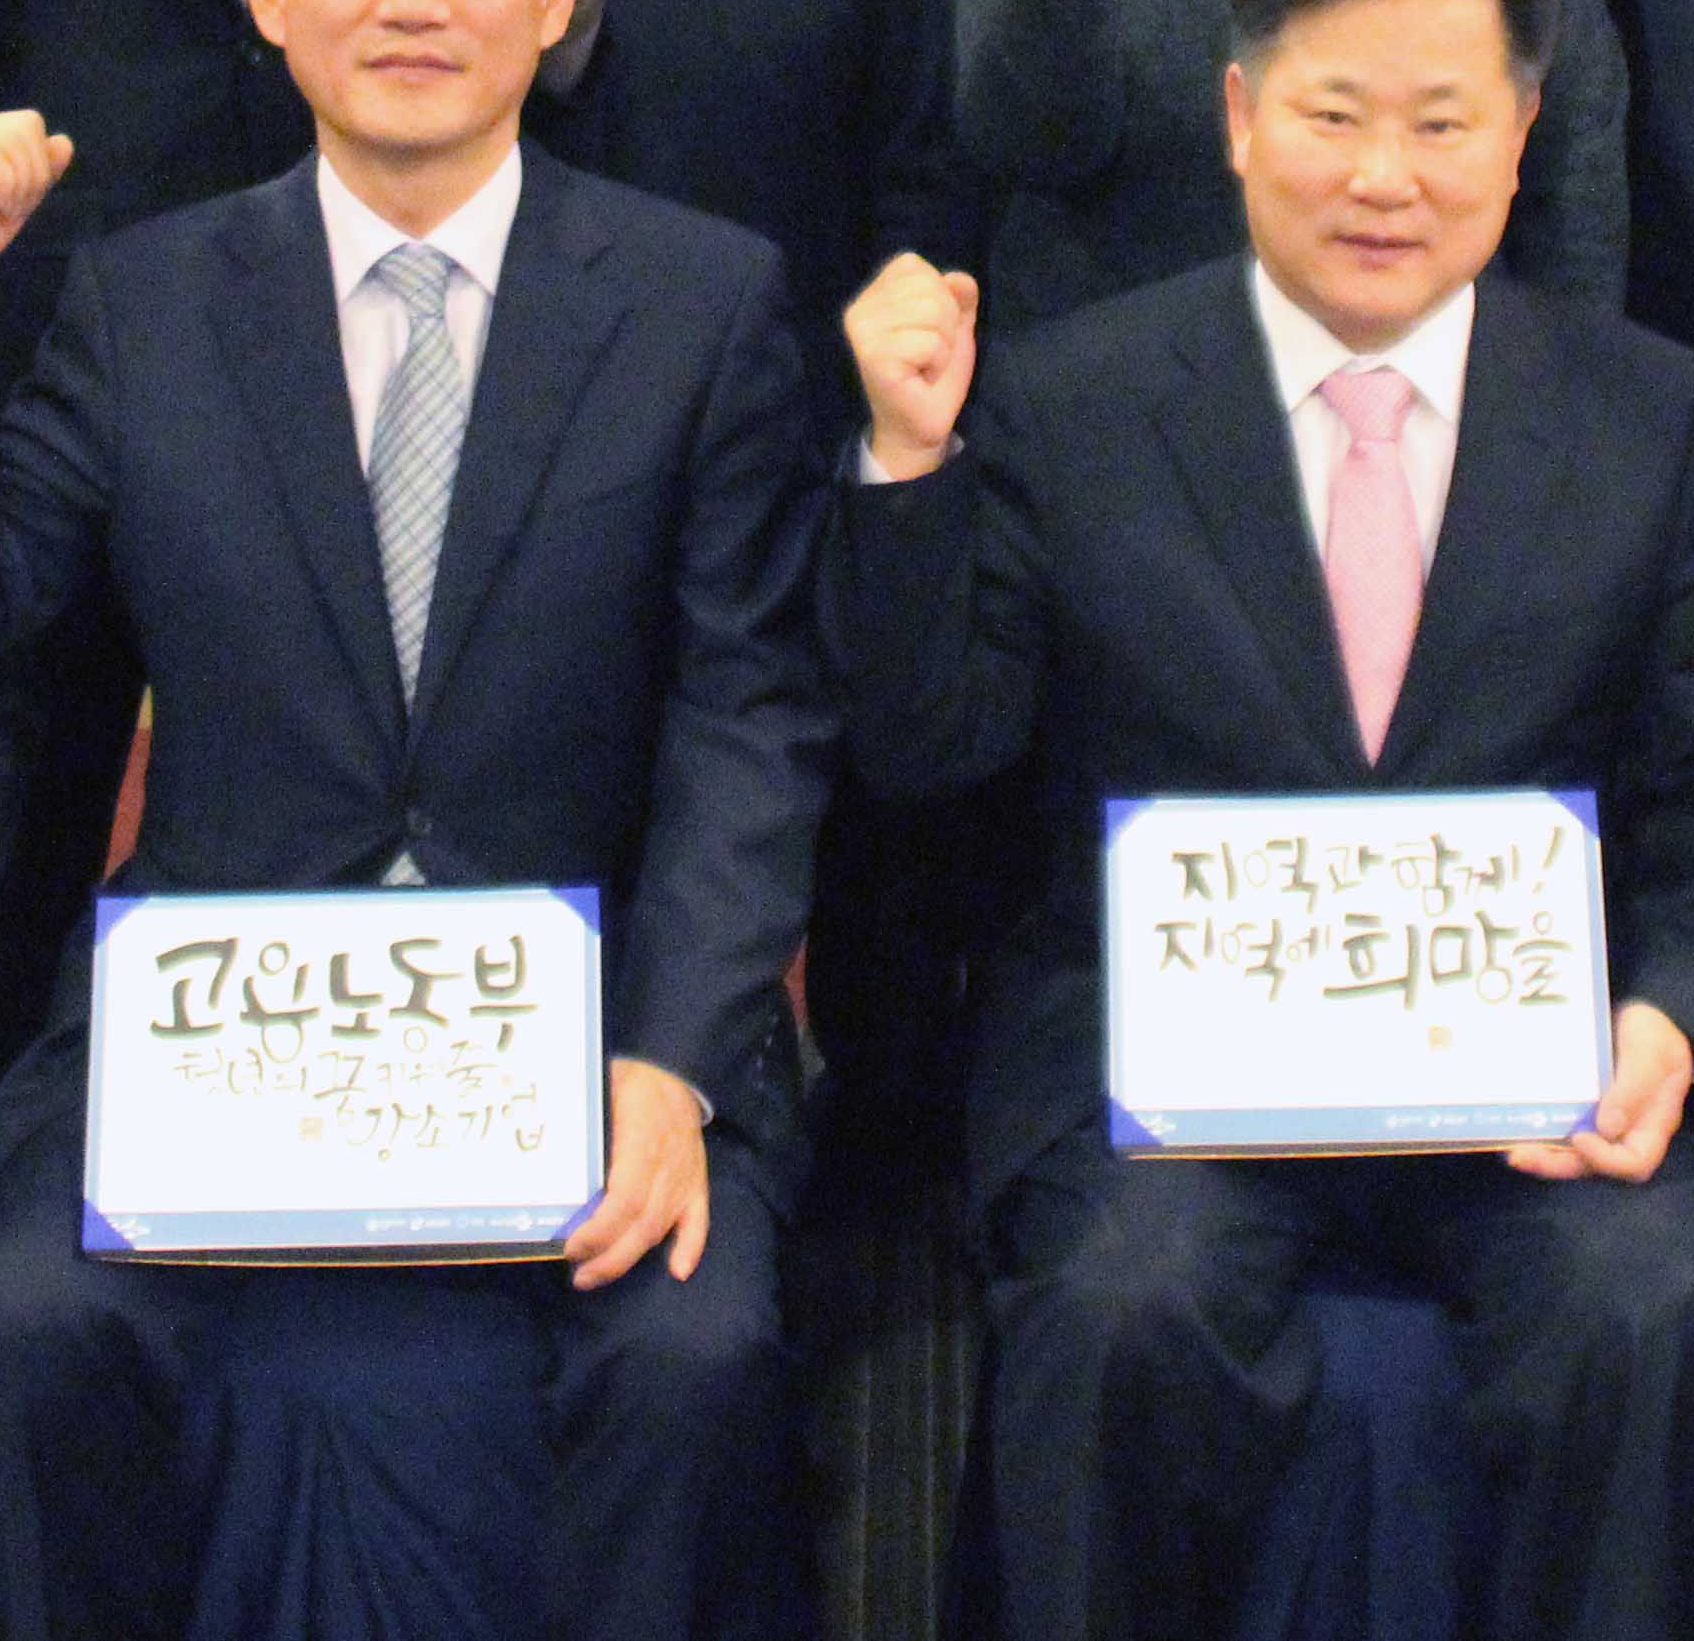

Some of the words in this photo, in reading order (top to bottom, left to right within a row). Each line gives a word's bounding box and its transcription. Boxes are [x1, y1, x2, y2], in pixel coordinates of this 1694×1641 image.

[1171, 836, 1385, 914] 지역과
[148, 933, 541, 1064] 고용노동부
[1154, 915, 1331, 1002] 지역에
[1321, 909, 1573, 1010] 희망을
